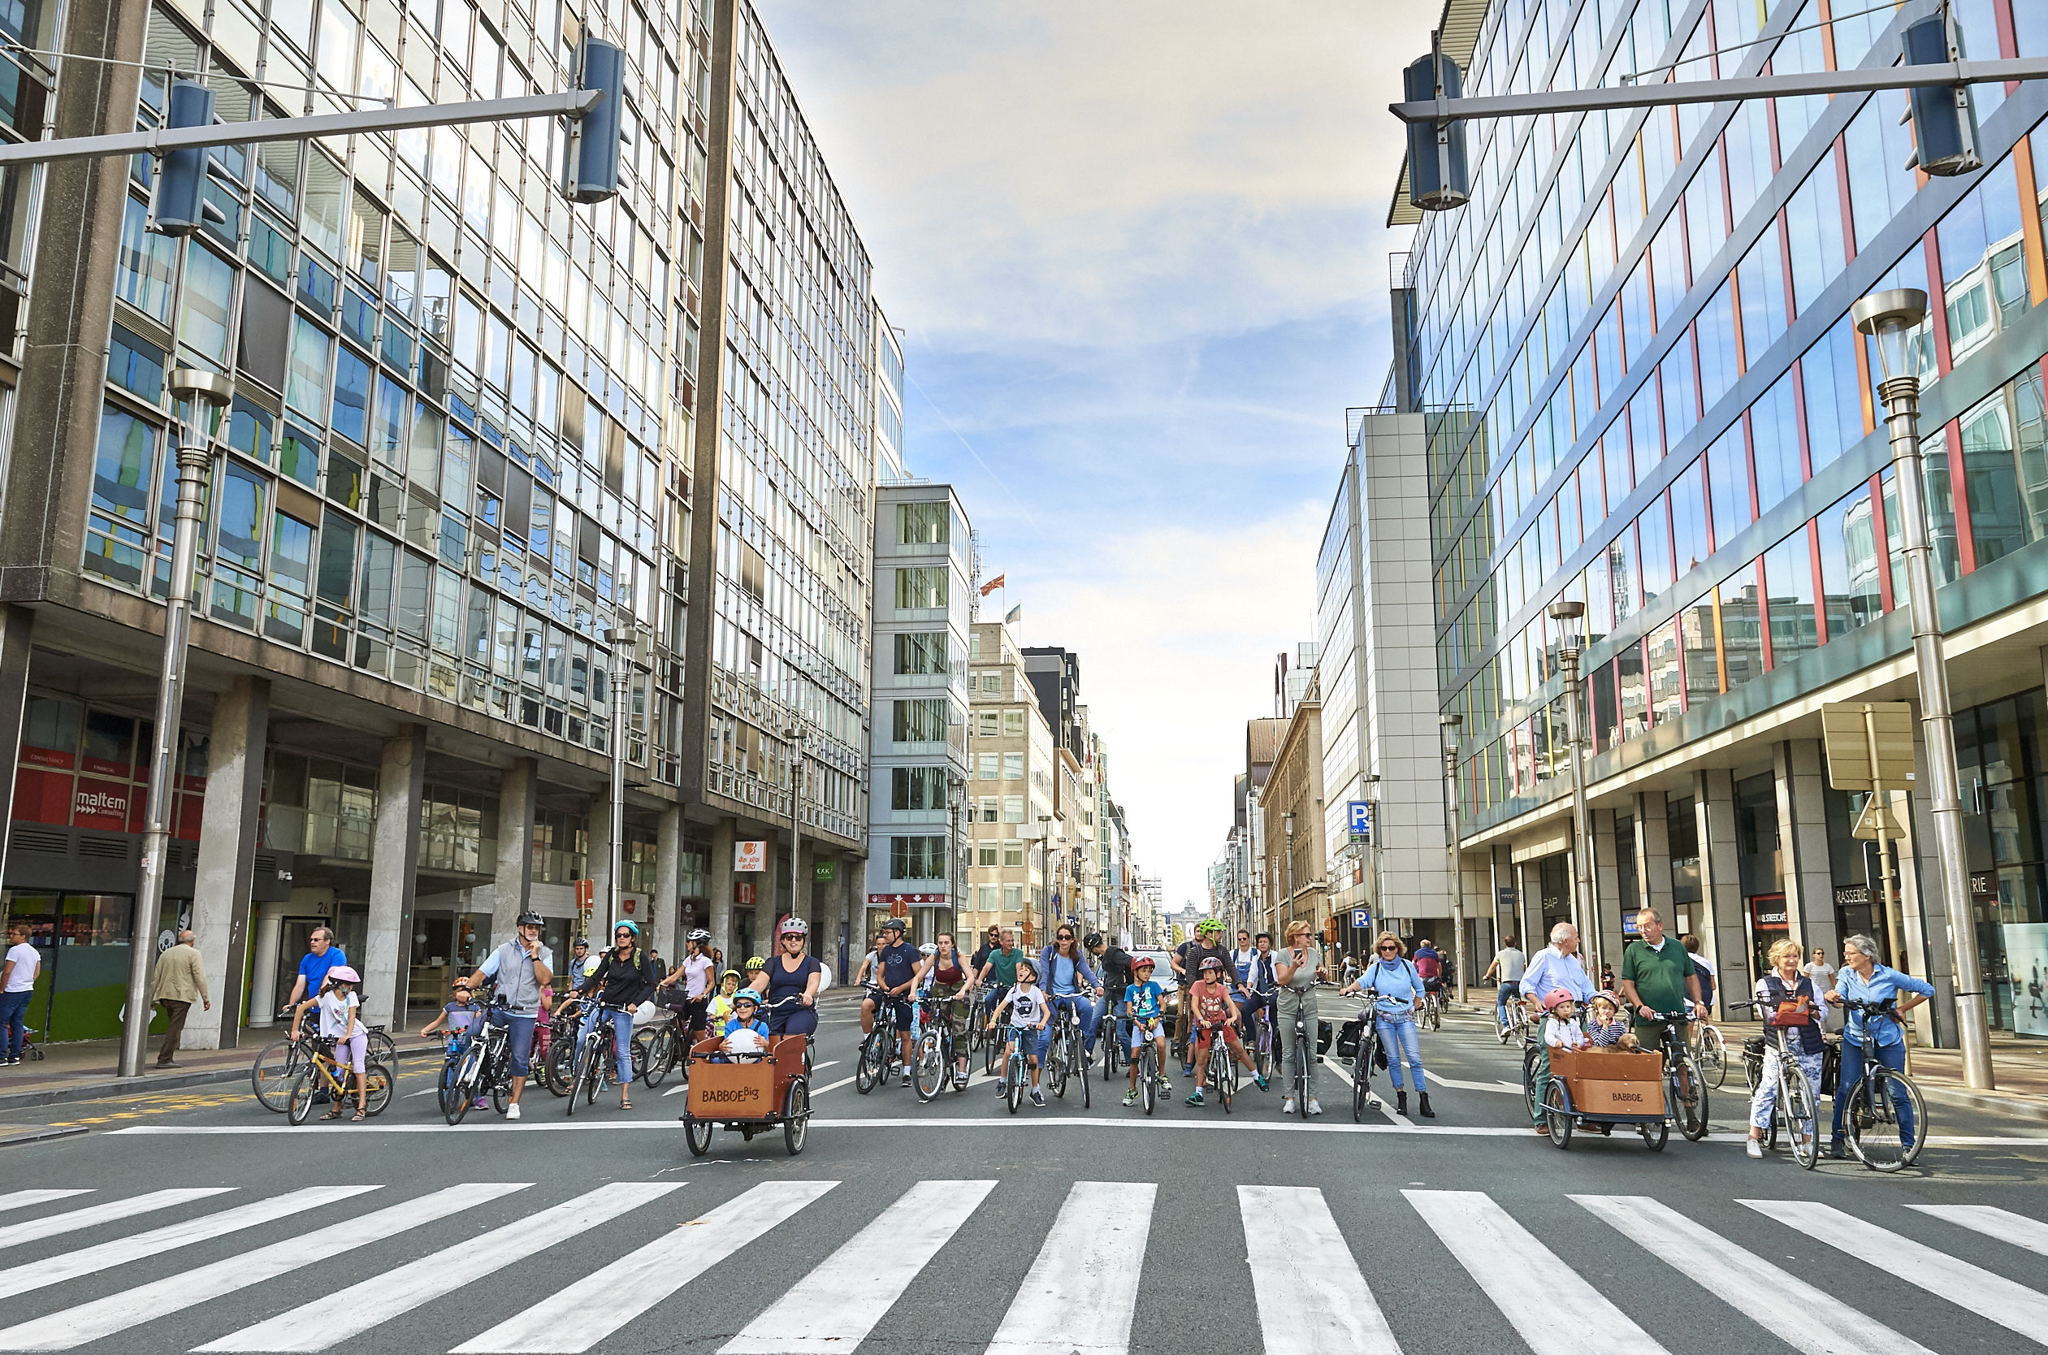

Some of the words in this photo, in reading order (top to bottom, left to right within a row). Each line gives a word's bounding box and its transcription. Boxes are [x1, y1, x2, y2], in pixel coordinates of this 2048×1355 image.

[77, 792, 126, 810] maltem
[317, 902, 329, 914] 26
[1355, 911, 1366, 926] P
[702, 1090, 746, 1102] BABBOE
[1612, 1092, 1644, 1103] BABBOE
